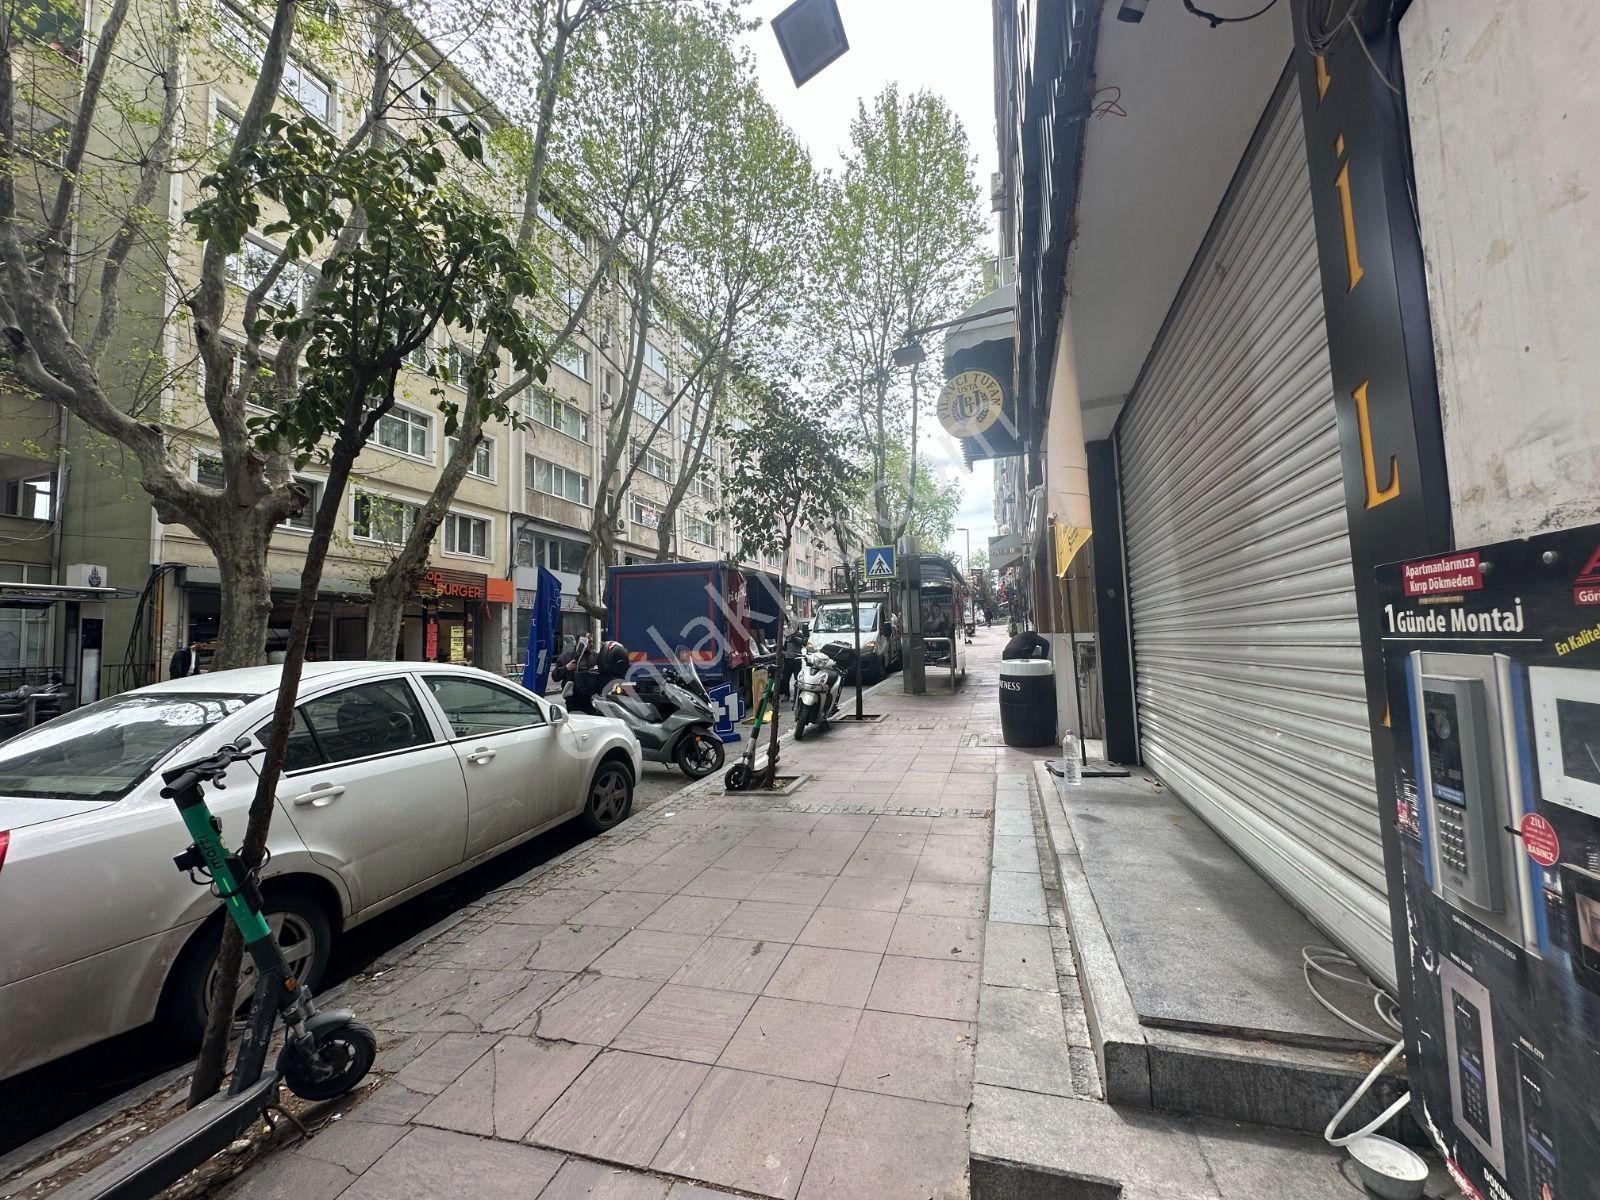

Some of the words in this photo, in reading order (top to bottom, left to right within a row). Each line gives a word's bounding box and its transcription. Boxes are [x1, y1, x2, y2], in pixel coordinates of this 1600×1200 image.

[957, 382, 978, 394] USTA
[973, 372, 1001, 407] TUFAN
[1405, 557, 1476, 578] Apartmanlarınıza
[425, 571, 441, 584] op
[1409, 580, 1427, 593] Kırıp
[1428, 574, 1474, 590] Dökmeden
[437, 583, 481, 598] BURGER
[1384, 603, 1396, 633] 1
[1397, 609, 1447, 633] Günde
[1450, 597, 1524, 633] Montaj
[1554, 641, 1570, 656] En
